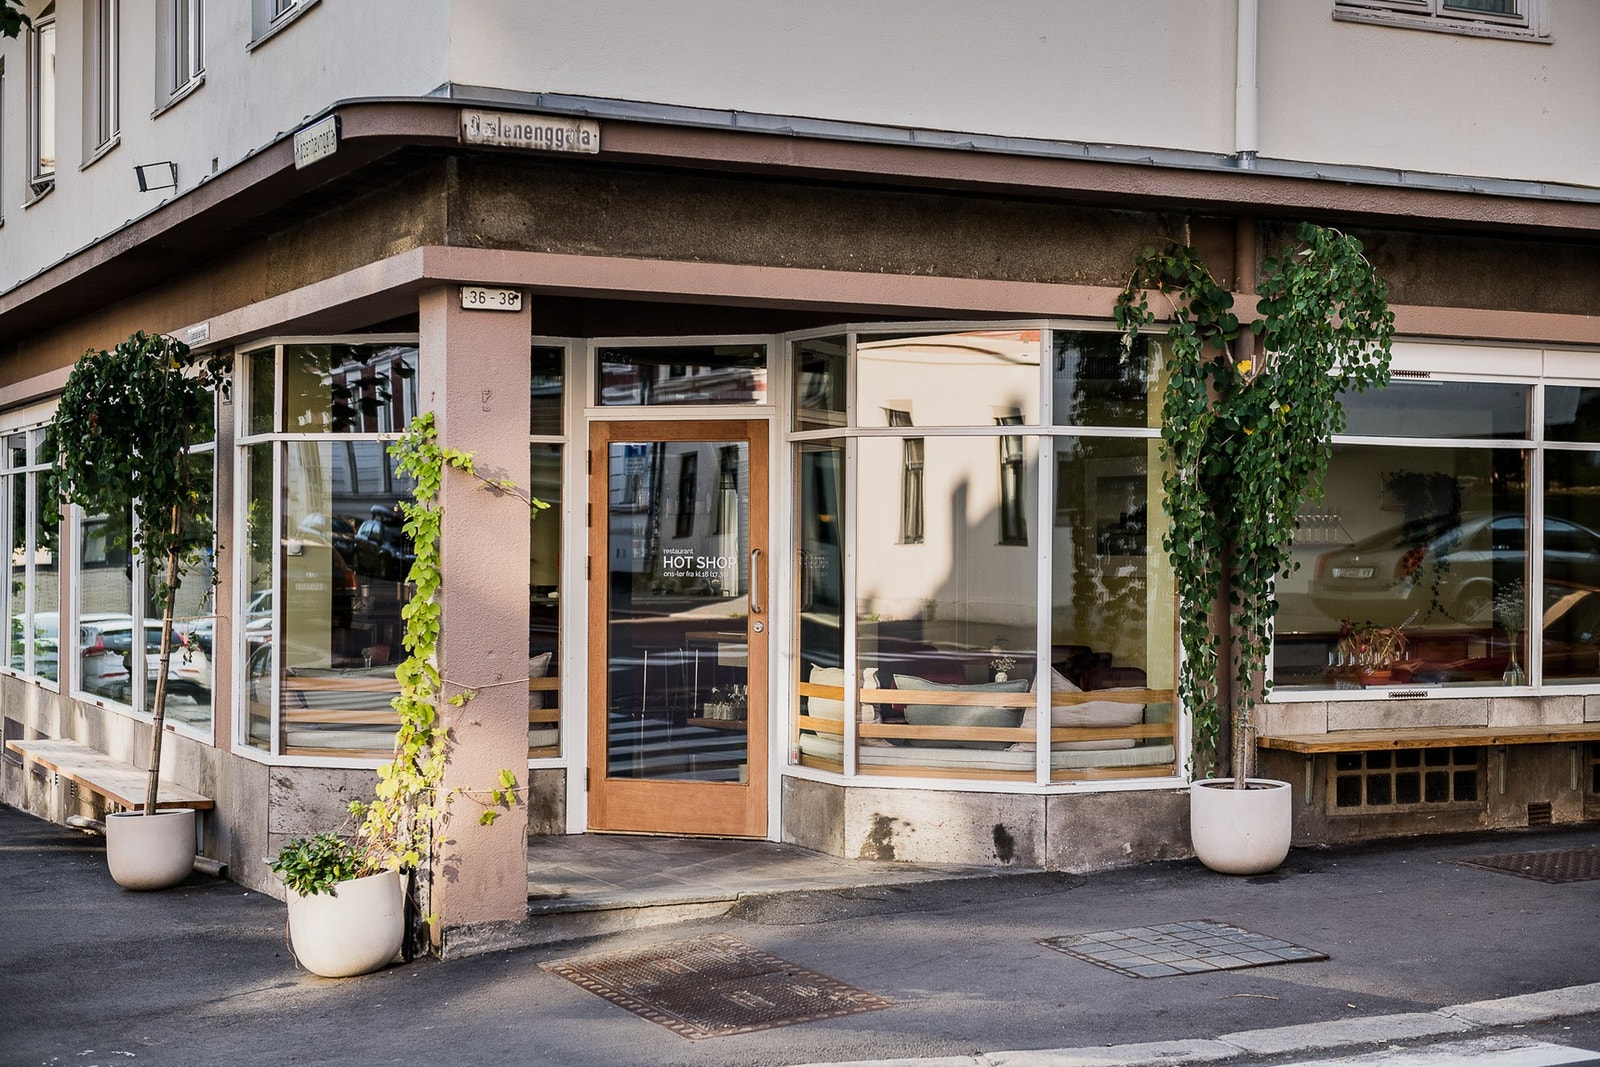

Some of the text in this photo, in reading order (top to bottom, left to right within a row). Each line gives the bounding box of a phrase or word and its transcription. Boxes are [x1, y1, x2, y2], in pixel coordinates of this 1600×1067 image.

[663, 556, 737, 569] HOT SHOP
[686, 570, 695, 578] fra
